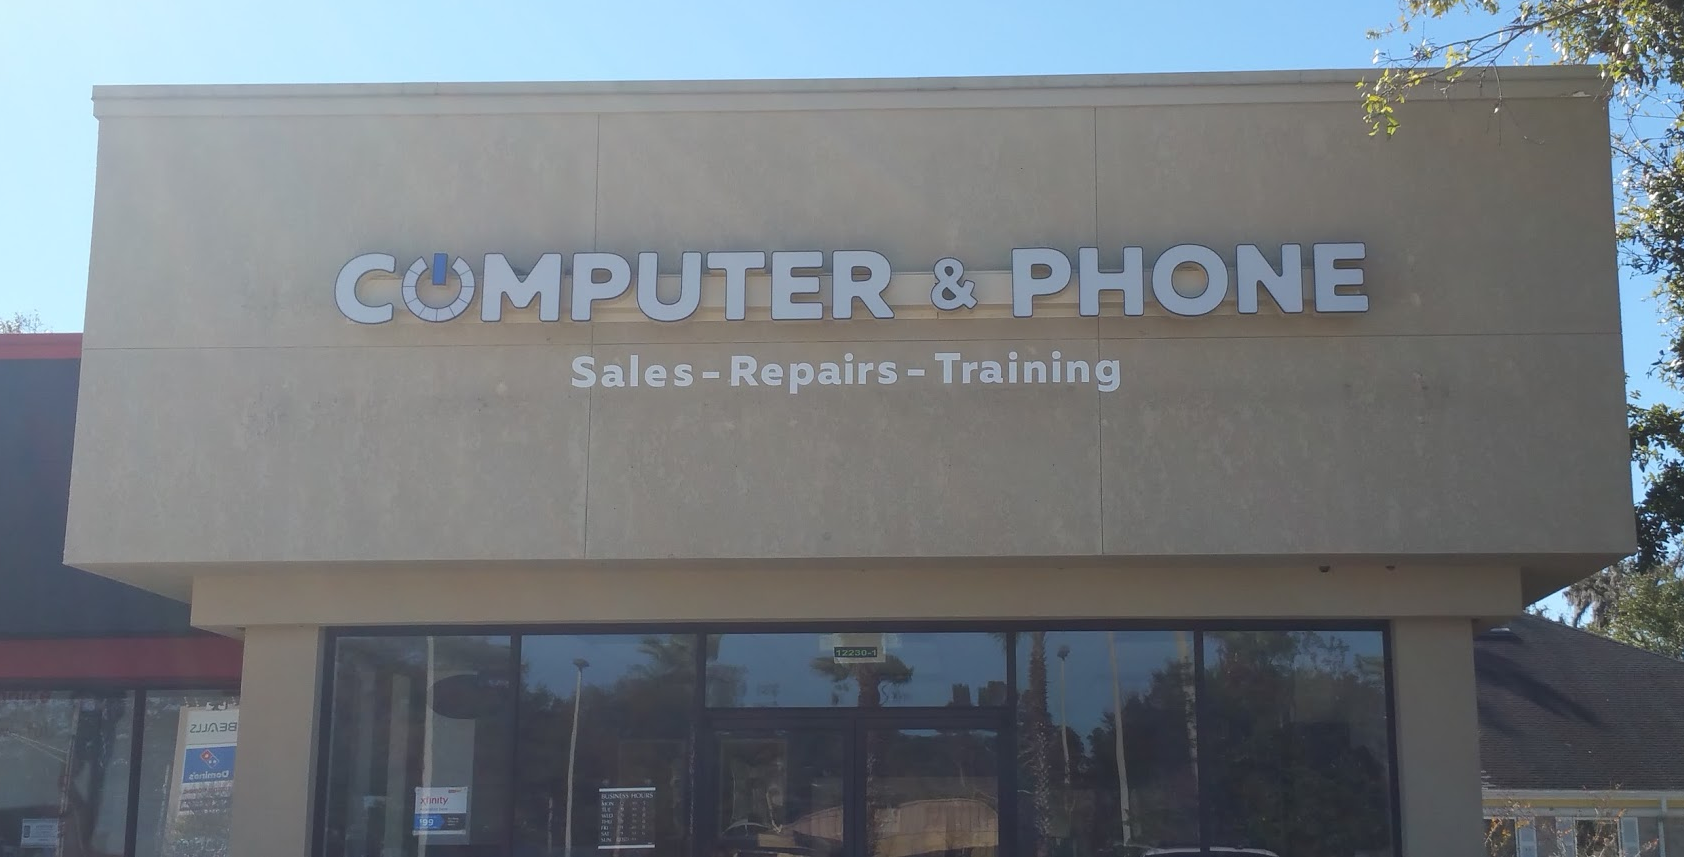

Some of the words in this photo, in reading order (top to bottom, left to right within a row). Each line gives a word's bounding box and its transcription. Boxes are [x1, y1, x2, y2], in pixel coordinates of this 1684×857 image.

[334, 249, 895, 324] COMPUTER
[930, 257, 978, 311] &
[1011, 242, 1369, 318] PHONE
[571, 354, 694, 388] Sales
[730, 353, 898, 394] Repairs
[935, 351, 1122, 392] Training
